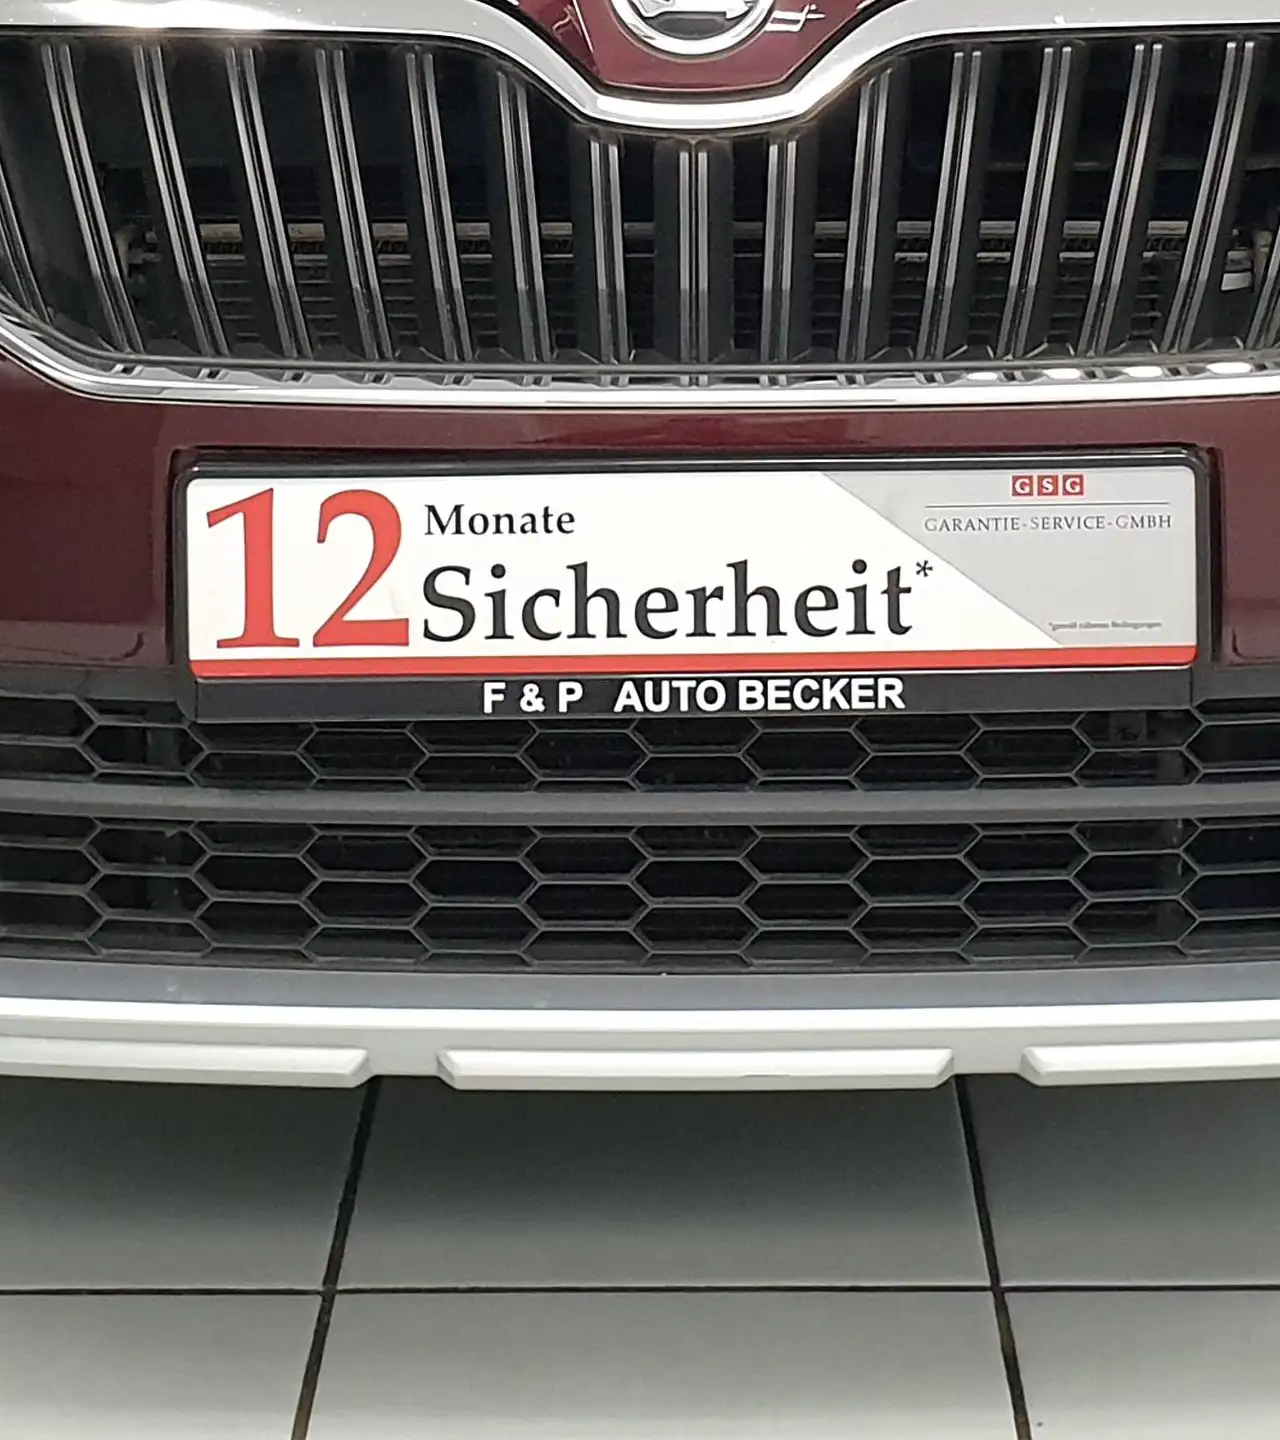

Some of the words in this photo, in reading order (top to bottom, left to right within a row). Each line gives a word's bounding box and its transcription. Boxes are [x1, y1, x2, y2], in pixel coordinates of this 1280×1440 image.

[1013, 476, 1082, 496] GSG
[424, 503, 576, 537] Monate
[206, 487, 410, 648] 12
[482, 681, 507, 714] F
[519, 682, 546, 713] &
[557, 680, 584, 713] P
[613, 679, 727, 713] AUTO
[737, 677, 907, 711] BECKER
